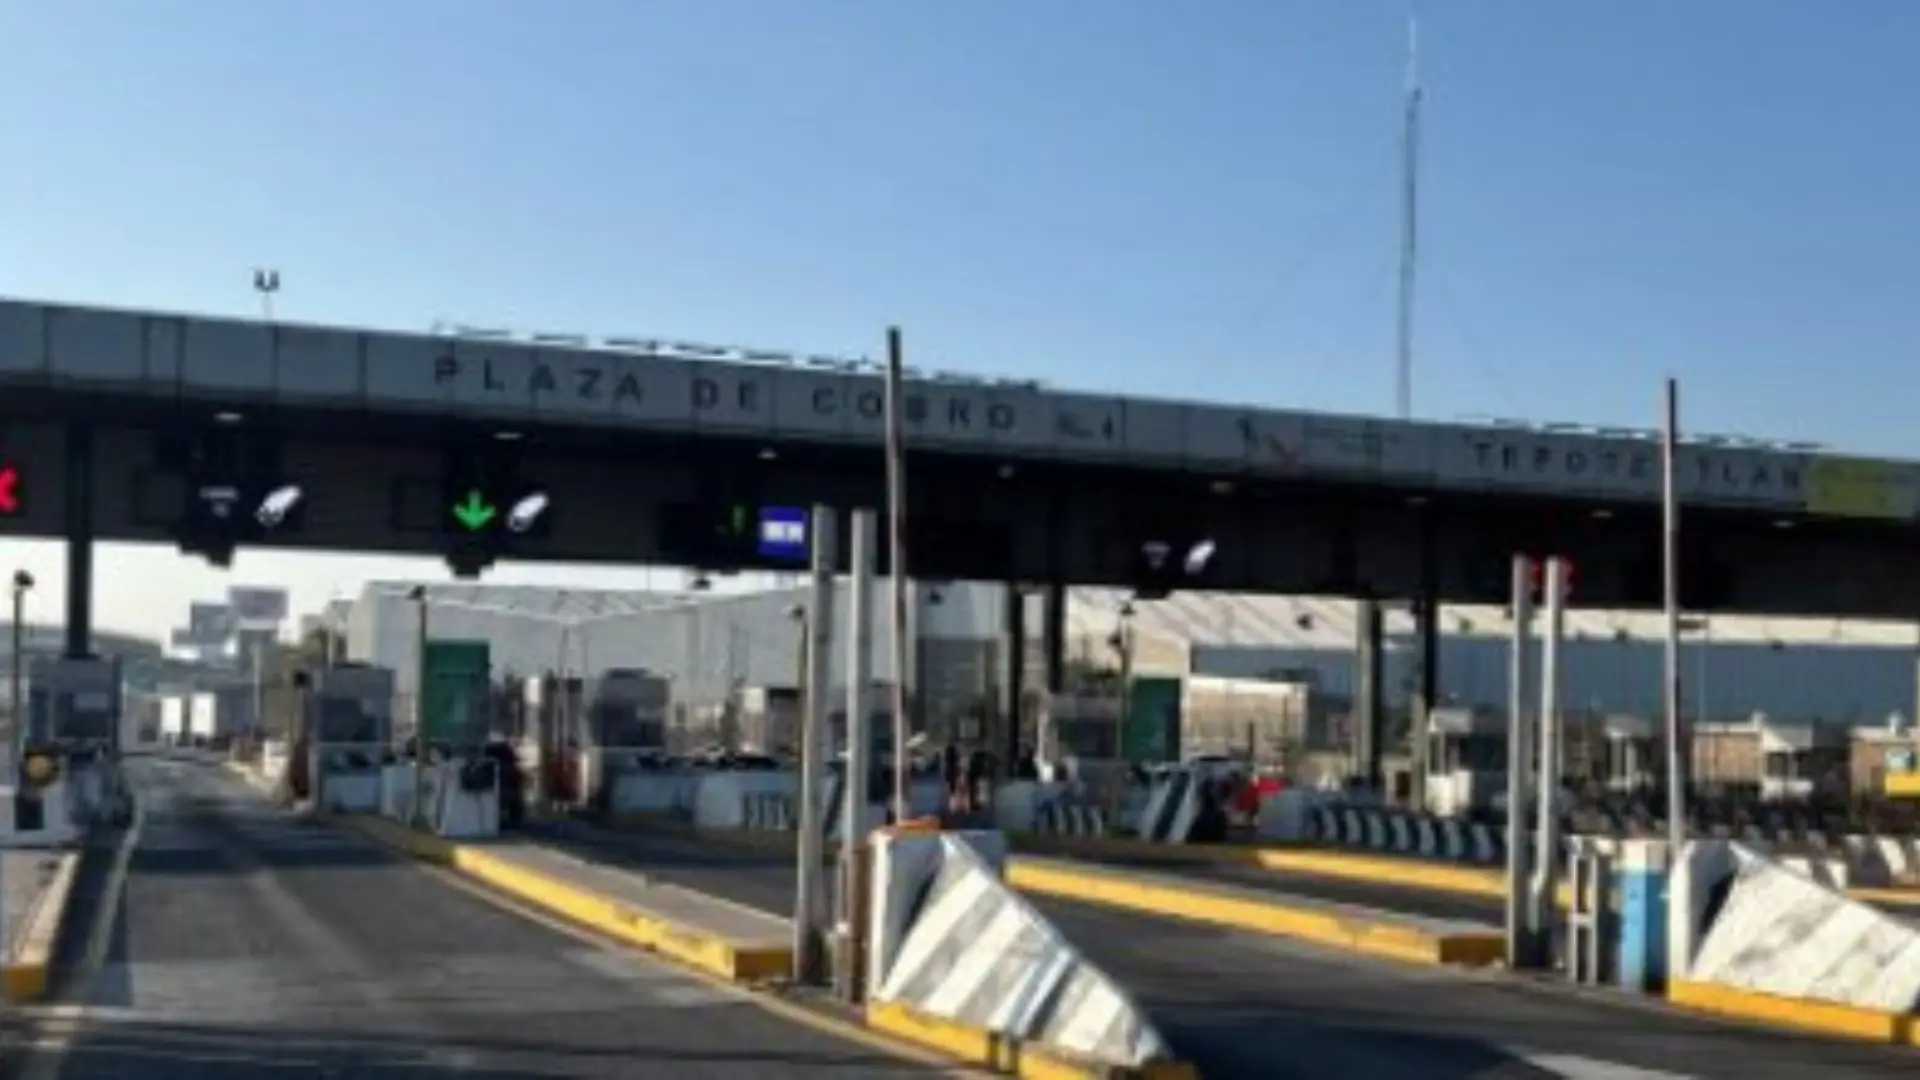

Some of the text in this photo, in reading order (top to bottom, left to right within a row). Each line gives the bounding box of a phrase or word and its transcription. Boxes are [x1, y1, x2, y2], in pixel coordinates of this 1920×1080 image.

[434, 356, 643, 403] PLAZA
[692, 378, 759, 411] DE
[812, 387, 1014, 429] COBRO
